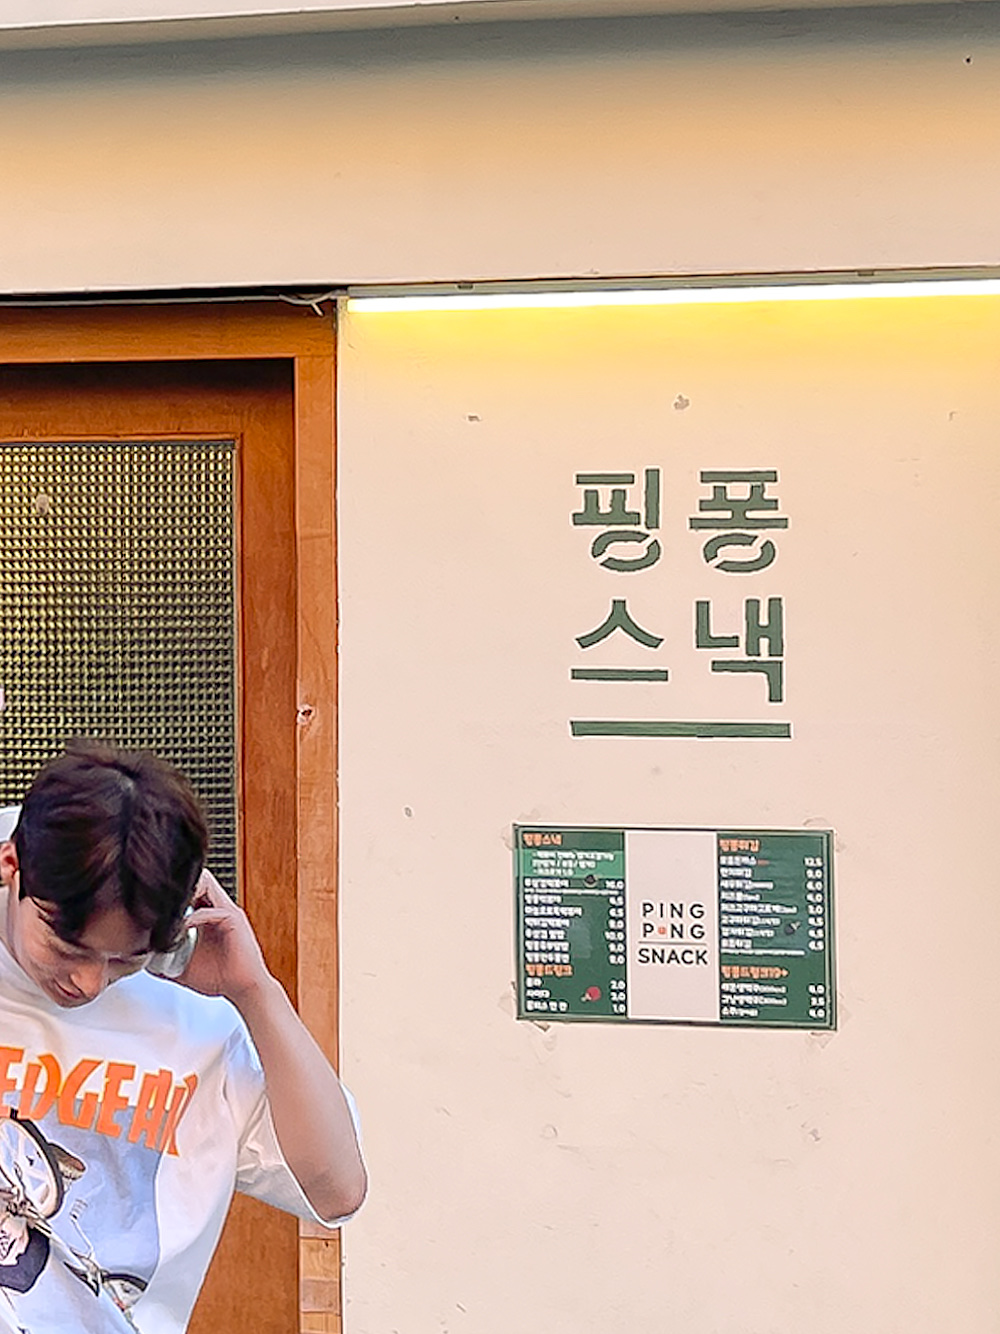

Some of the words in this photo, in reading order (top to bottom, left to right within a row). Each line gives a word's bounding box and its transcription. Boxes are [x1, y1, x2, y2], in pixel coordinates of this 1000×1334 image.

[572, 468, 788, 573] 핑퐁
[571, 598, 783, 703] 스낵
[643, 903, 705, 919] PING
[638, 948, 708, 965] SNACK
